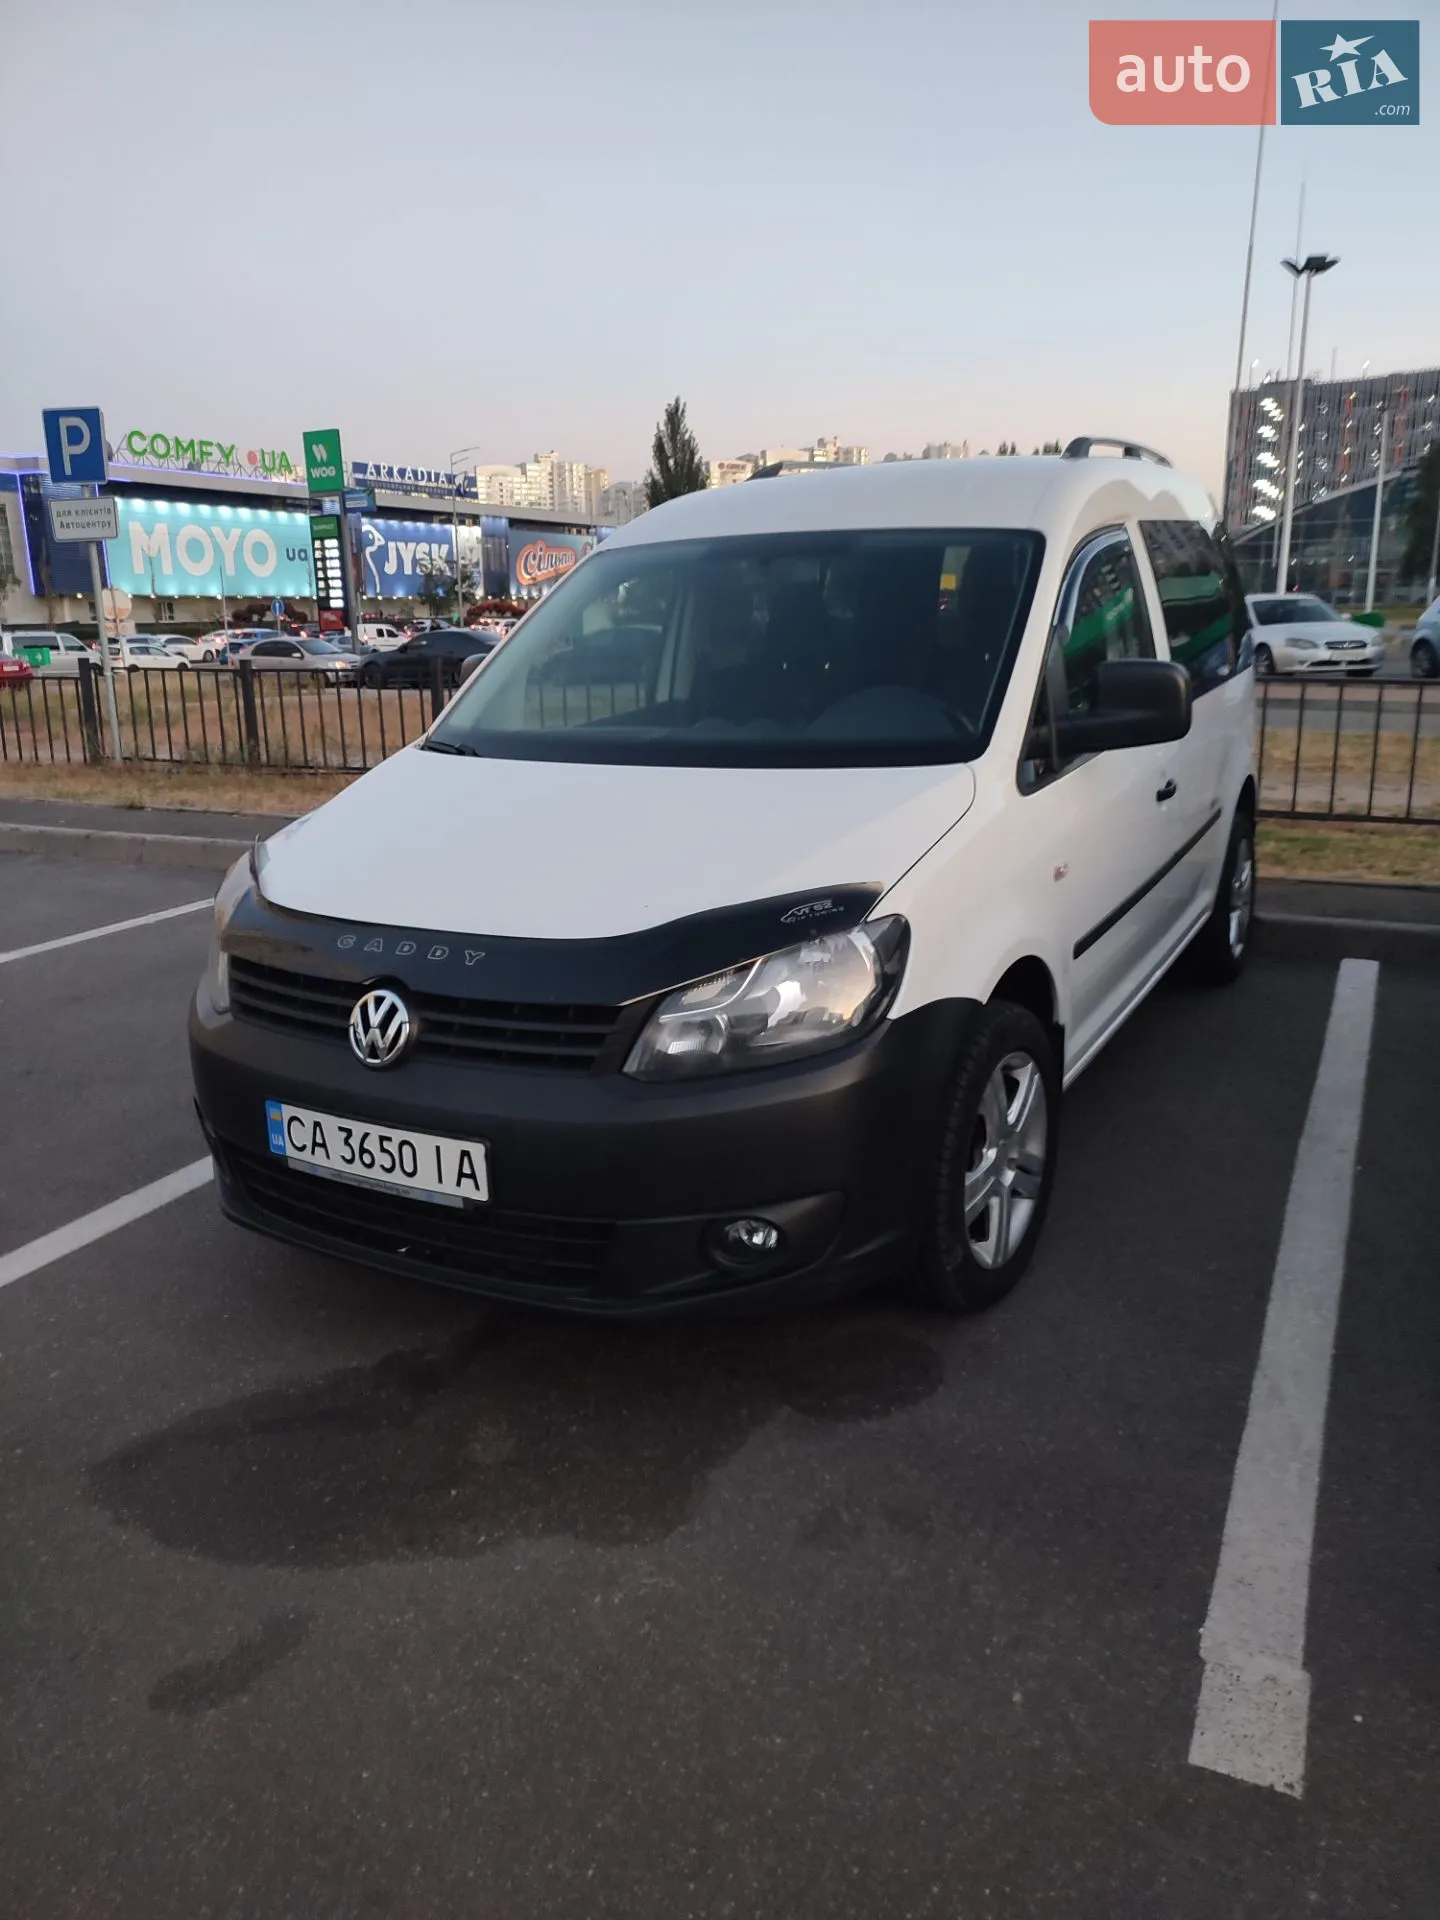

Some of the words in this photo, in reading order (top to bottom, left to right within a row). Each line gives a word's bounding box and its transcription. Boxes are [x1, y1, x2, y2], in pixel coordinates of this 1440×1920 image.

[58, 416, 91, 477] P
[127, 430, 236, 465] COMFY
[310, 466, 336, 478] WOG
[366, 460, 448, 486] ARKADIA
[128, 520, 278, 578] MOYO
[383, 540, 451, 577] JYSK
[271, 1133, 285, 1147] UA
[286, 1115, 331, 1160] CA
[337, 1125, 419, 1178] 3650
[435, 1144, 481, 1192] IA
